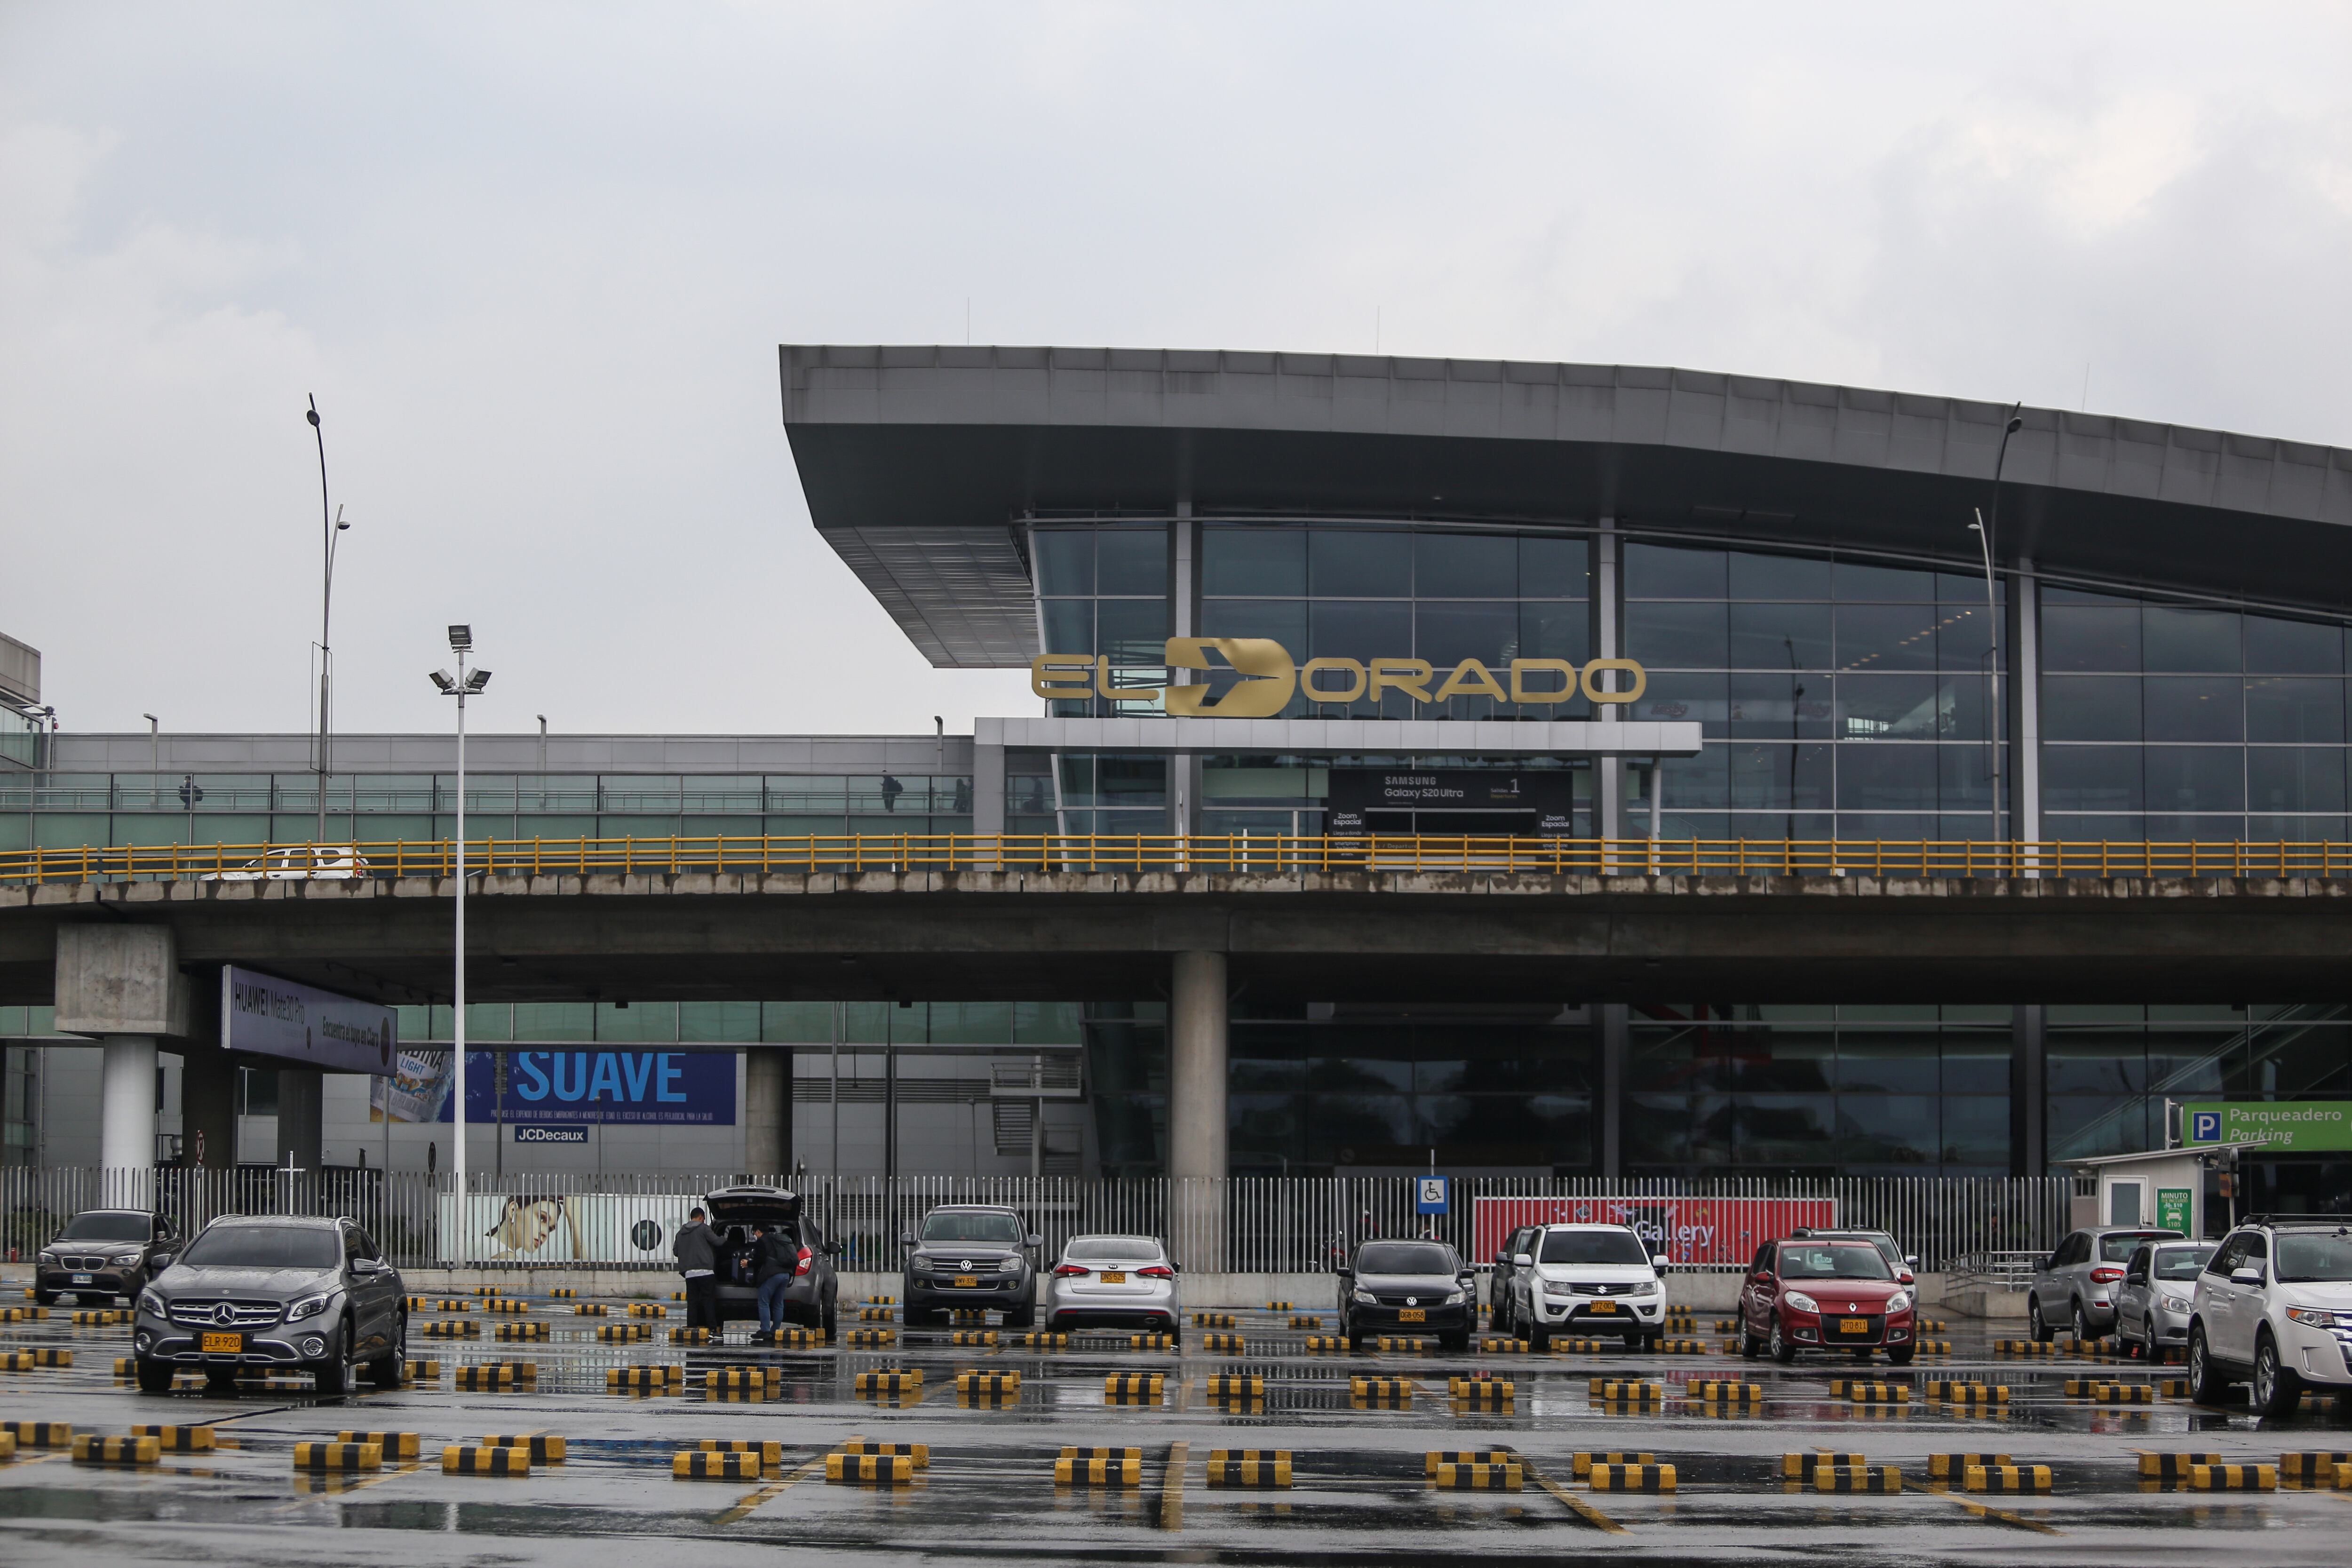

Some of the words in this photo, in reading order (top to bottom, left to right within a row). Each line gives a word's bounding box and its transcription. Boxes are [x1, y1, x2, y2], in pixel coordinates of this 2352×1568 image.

[1385, 776, 1436, 785] SAMSUNG
[1511, 779, 1520, 793] 1
[1385, 788, 1420, 798] Galaxy
[235, 982, 268, 1016] HUAWEI
[295, 997, 305, 1025] Pro
[323, 1016, 345, 1041] Encuentra
[346, 1021, 350, 1042] el
[351, 1024, 360, 1048] tuyo
[361, 1029, 366, 1045] en
[367, 1026, 379, 1048] Claro
[400, 1058, 425, 1075] LIGHT
[517, 1052, 686, 1102] SUAVE
[2198, 1115, 2215, 1138] P
[2230, 1108, 2342, 1123] Parqueadero
[519, 1129, 584, 1141] JCDecaux
[2229, 1128, 2294, 1145] Parking
